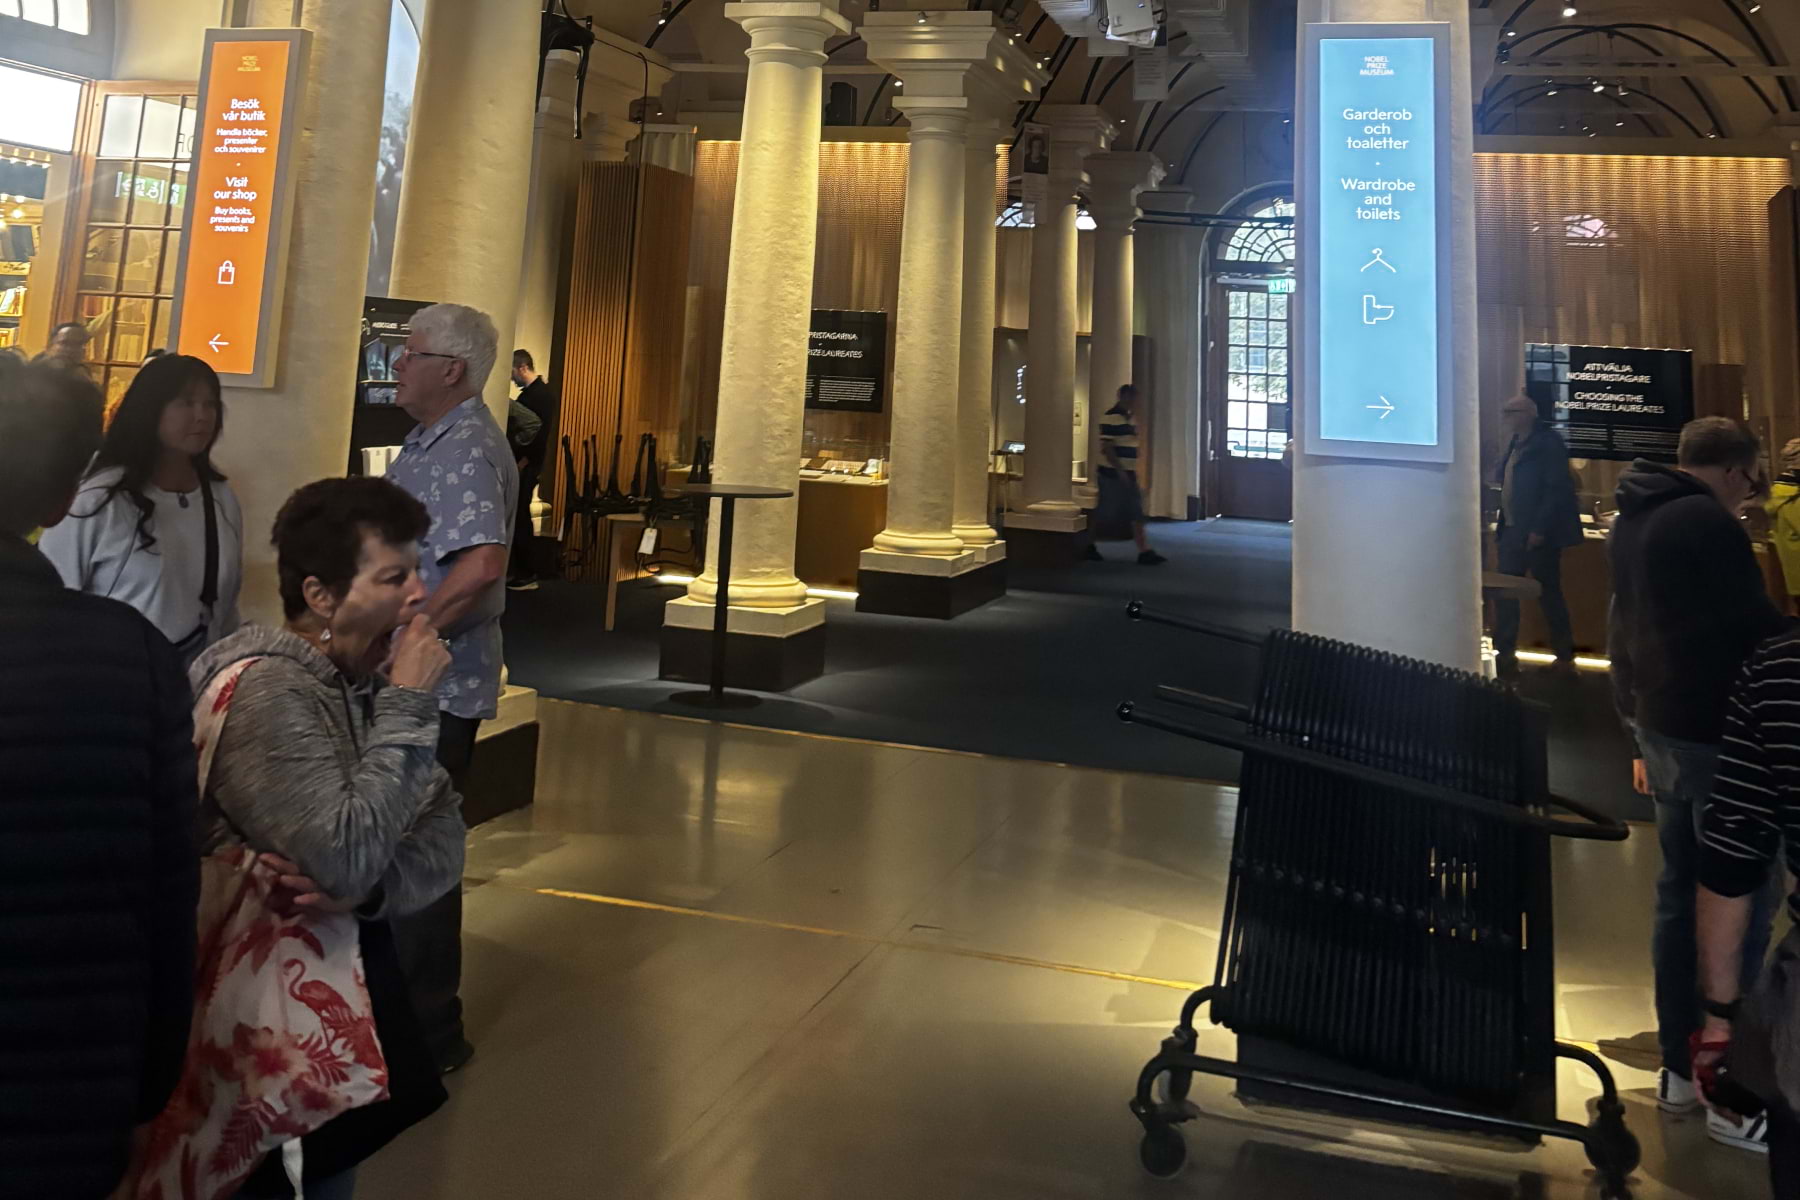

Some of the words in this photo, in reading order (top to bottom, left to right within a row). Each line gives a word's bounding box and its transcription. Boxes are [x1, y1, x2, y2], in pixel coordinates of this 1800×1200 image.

[230, 98, 260, 109] Besök
[222, 110, 240, 121] vår
[240, 110, 266, 121] butik
[1343, 108, 1412, 121] Garderob
[216, 128, 241, 136] Handla
[1363, 123, 1391, 135] och
[223, 137, 259, 146] presenter
[1346, 137, 1409, 150] toaletter
[214, 145, 228, 153] och
[225, 176, 248, 188] Visit
[1341, 177, 1416, 191] Wardrobe
[213, 190, 231, 200] our
[231, 188, 257, 202] shop
[1364, 193, 1392, 206] and
[214, 206, 228, 216] Buy
[1356, 207, 1401, 221] toilets
[209, 215, 240, 224] presents
[241, 215, 256, 224] and
[214, 225, 249, 233] souvenirs
[808, 331, 858, 341] PRISTAGARNA
[807, 348, 822, 357] RIZE
[822, 349, 864, 359] LAUREATES
[1566, 372, 1652, 384] NOBELPRISTAGARE
[1574, 391, 1625, 402] CHOOSING
[1625, 394, 1645, 403] THE
[1554, 401, 1586, 410] NOBEL
[1586, 402, 1612, 411] PRIZE
[1612, 404, 1665, 414] LAUREATES
